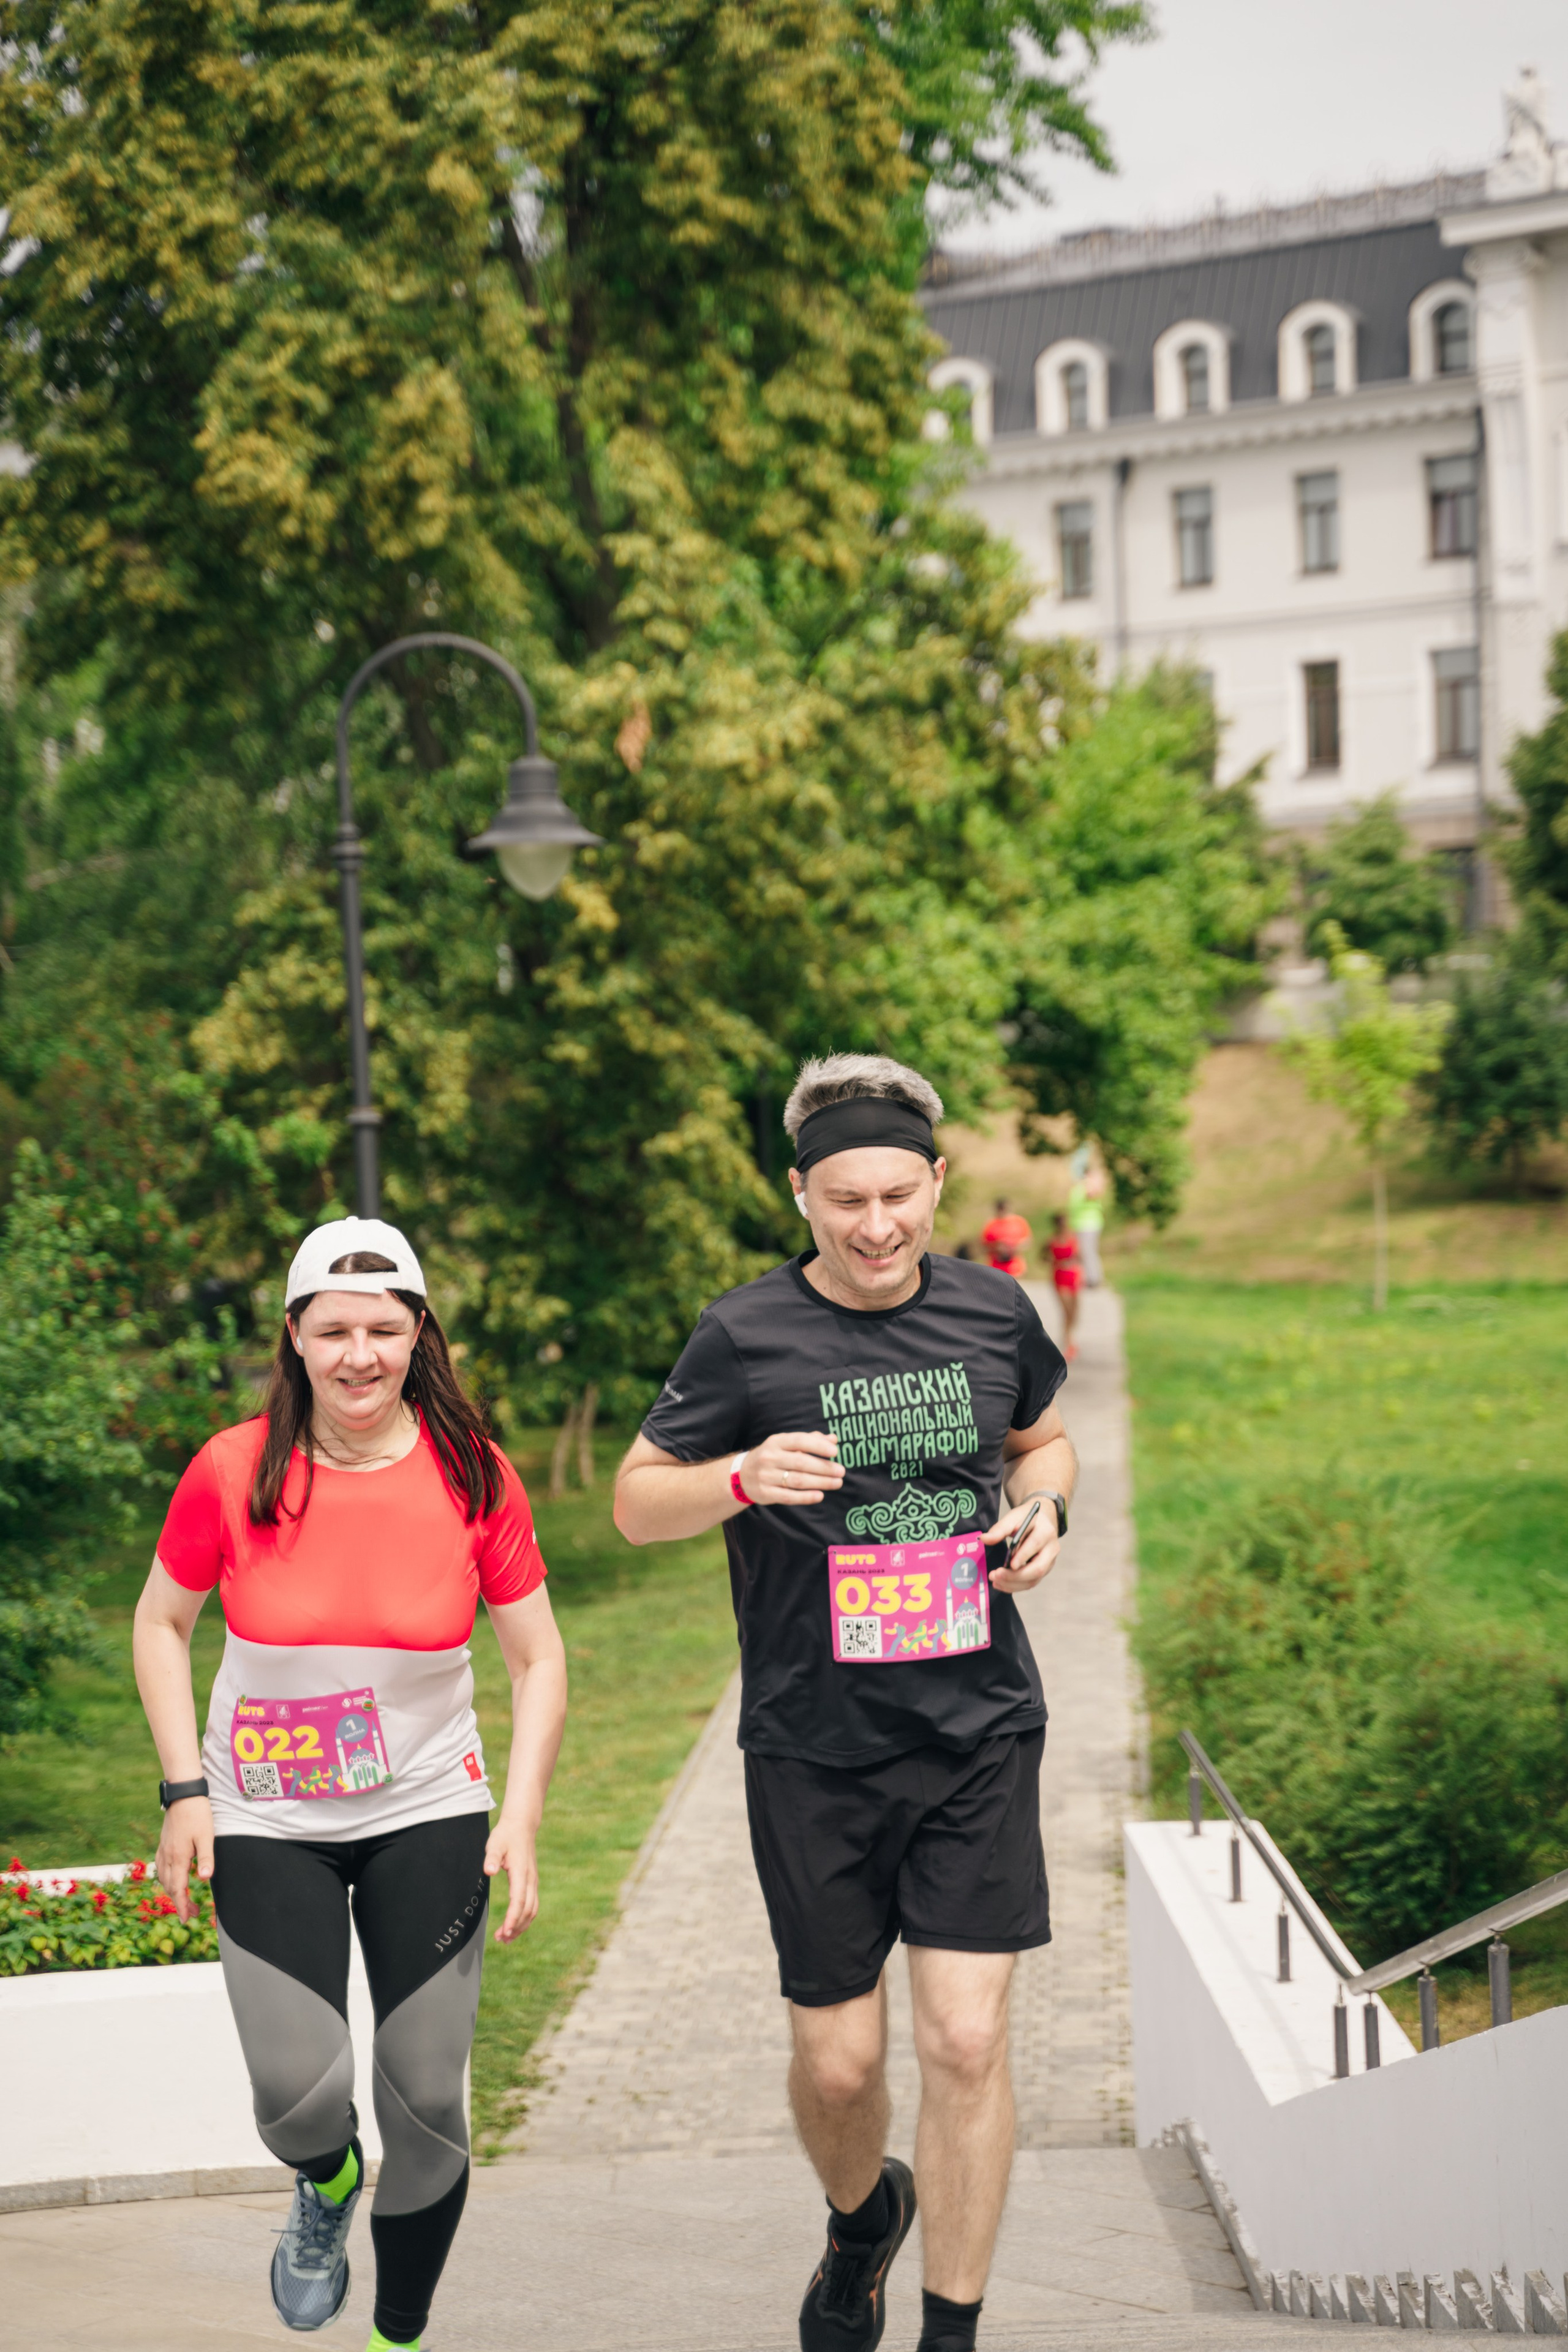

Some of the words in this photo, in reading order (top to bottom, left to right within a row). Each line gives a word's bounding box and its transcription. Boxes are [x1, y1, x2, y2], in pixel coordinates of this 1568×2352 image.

[820, 1362, 971, 1419] КАЗАНСКИЙ
[828, 1398, 974, 1442] НАЦИОНАЛЬНЫЙ
[891, 1460, 924, 1480] 2021
[835, 1554, 876, 1566] RUTS
[961, 1562, 969, 1577] 1
[835, 1573, 932, 1615] 033
[238, 1705, 265, 1717] RUTS
[345, 1728, 365, 1740] ВОЛНА
[346, 1719, 356, 1731] 1
[234, 1725, 324, 1762] 022
[435, 1919, 464, 1953] JUST
[465, 1896, 478, 1917] DO
